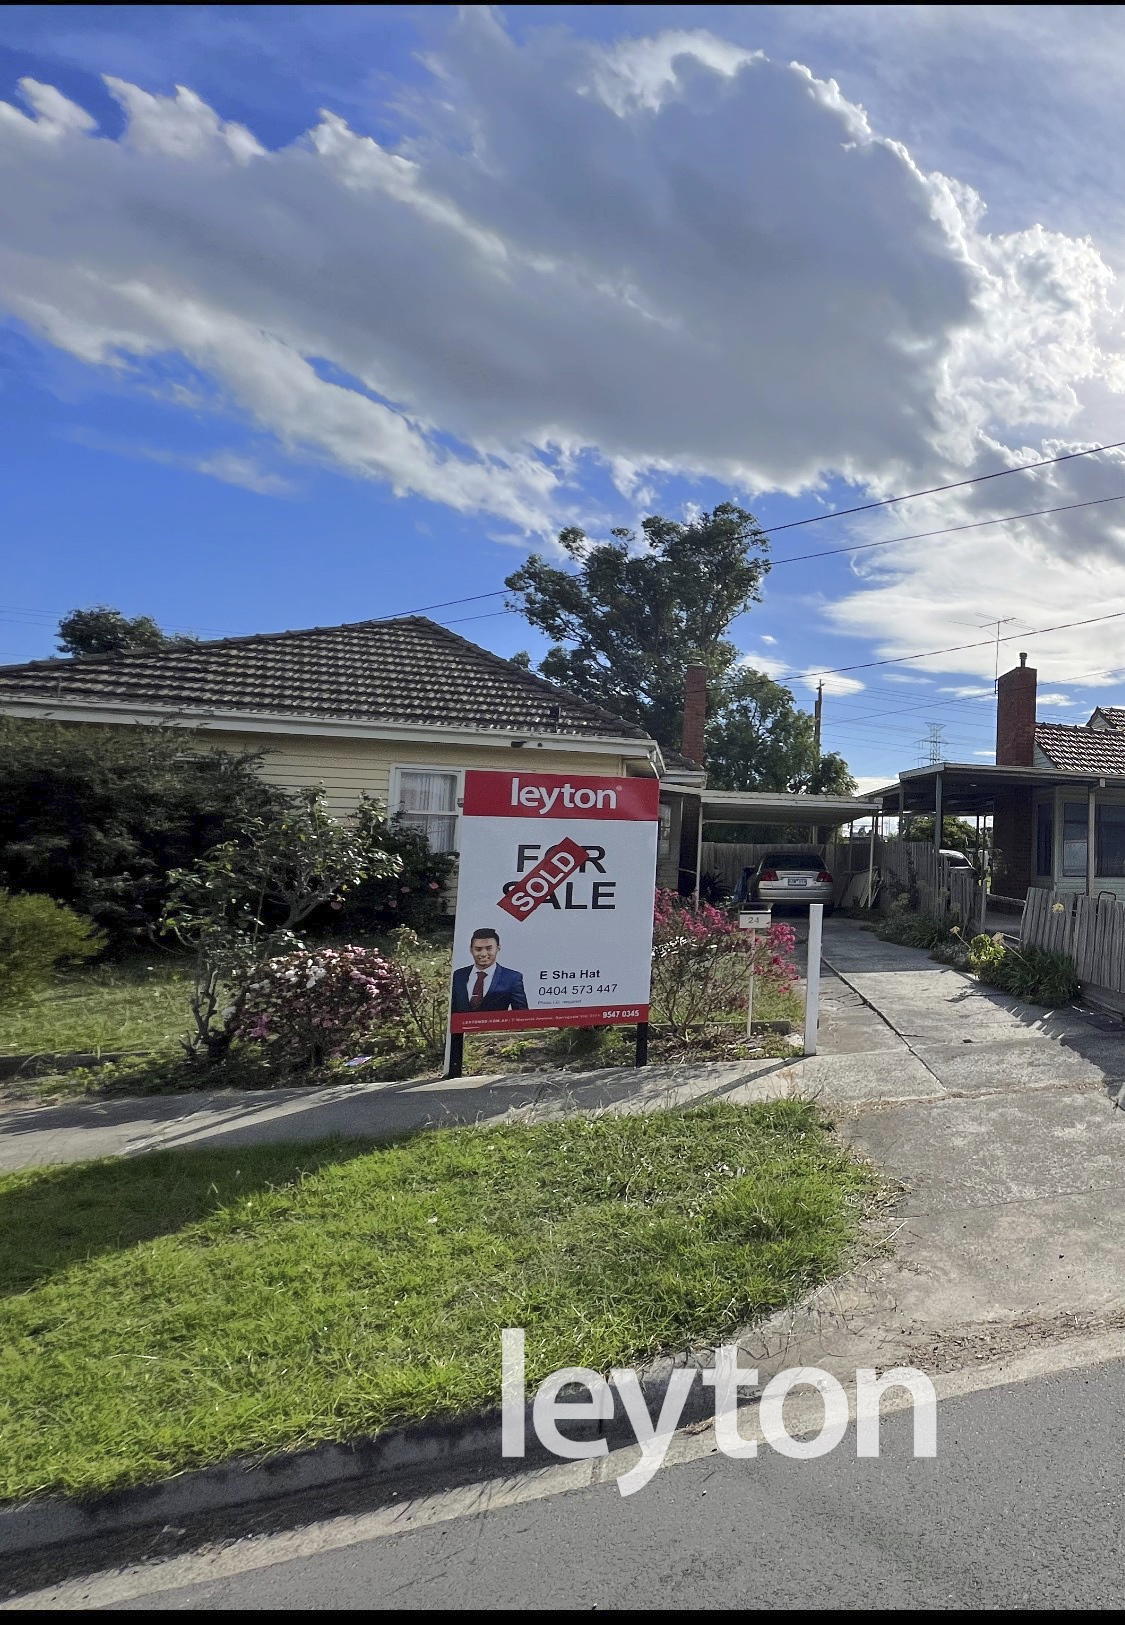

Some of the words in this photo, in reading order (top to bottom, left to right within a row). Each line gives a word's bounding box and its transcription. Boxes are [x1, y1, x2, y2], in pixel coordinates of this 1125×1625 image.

[511, 777, 617, 815] leyton
[516, 844, 607, 873] FR
[511, 851, 575, 912] SOLD
[748, 916, 760, 924] 24
[539, 970, 548, 980] E
[552, 970, 576, 980] Sha
[580, 969, 601, 979] Hat
[538, 986, 567, 996] 0404
[571, 984, 593, 995] 573
[596, 983, 618, 994] 447
[602, 1010, 621, 1019] 9547
[621, 1009, 640, 1018] 0345
